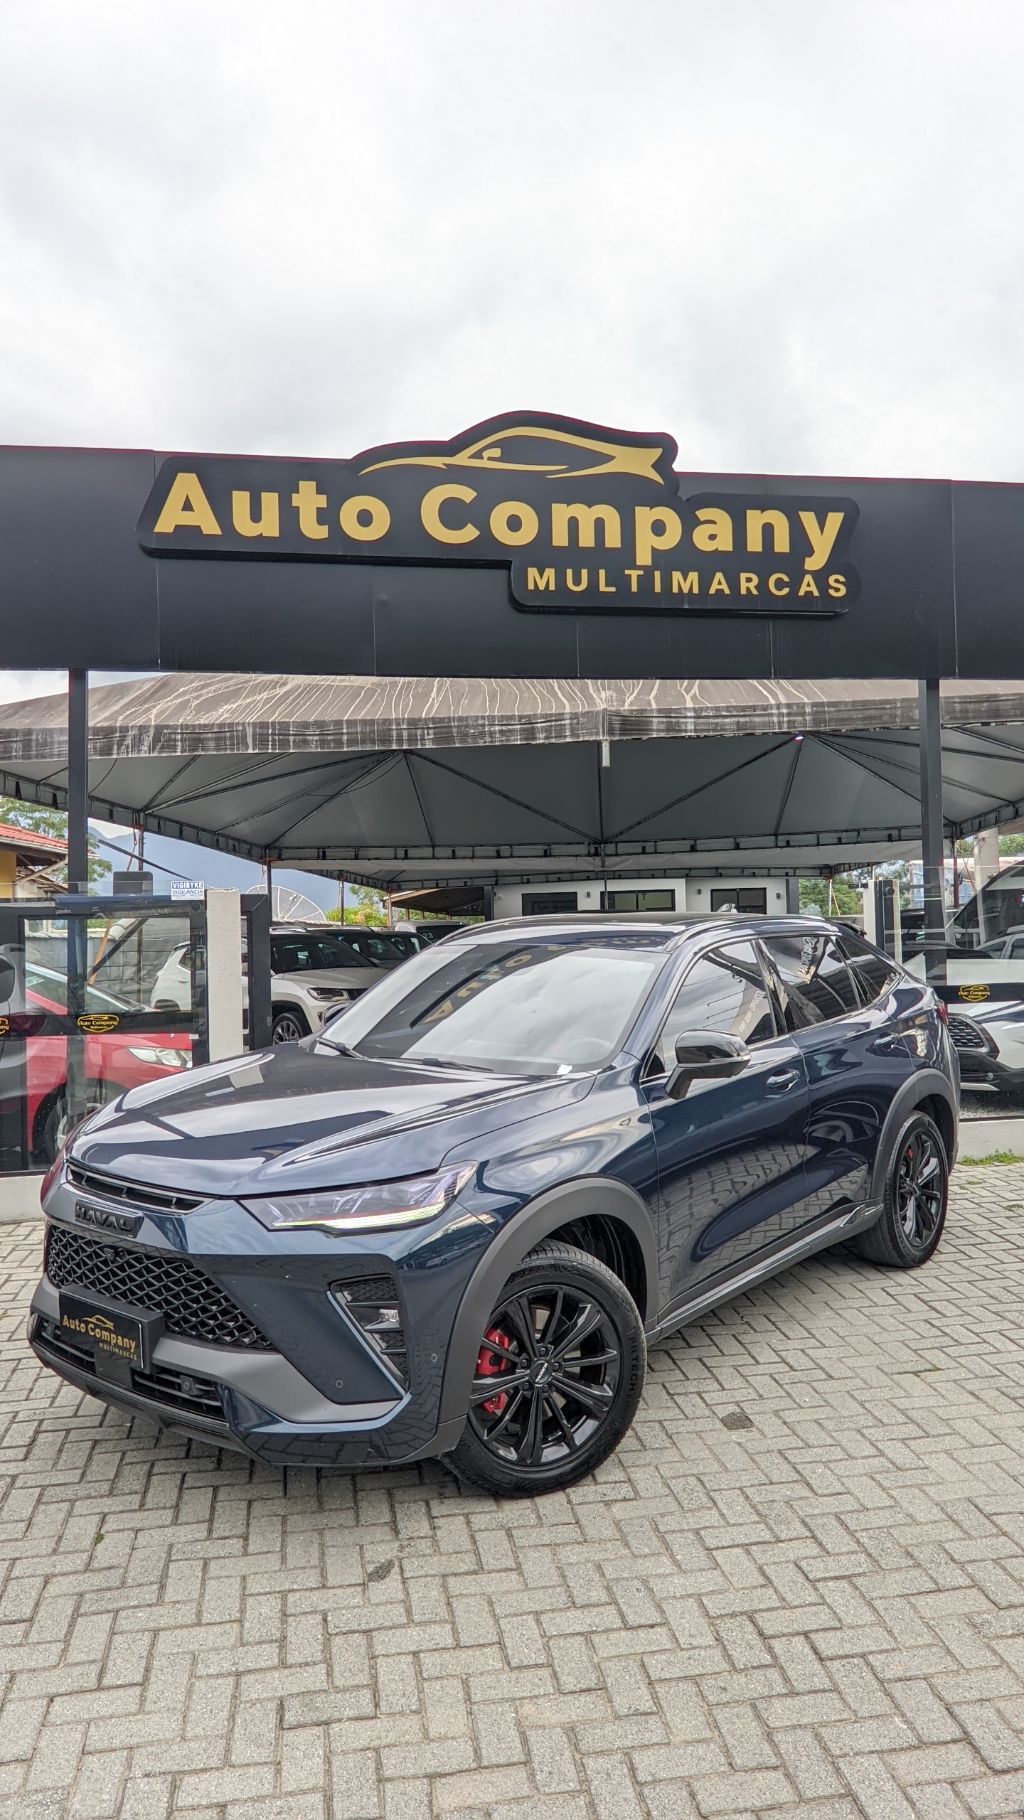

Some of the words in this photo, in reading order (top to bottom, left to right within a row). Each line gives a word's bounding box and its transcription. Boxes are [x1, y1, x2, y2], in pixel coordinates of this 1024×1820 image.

[153, 472, 388, 543] Auto
[420, 485, 844, 571] Company
[526, 567, 845, 598] MULTIMARCAS
[76, 1205, 133, 1232] HAVAL
[62, 1314, 87, 1333] Auto
[88, 1323, 136, 1353] Company
